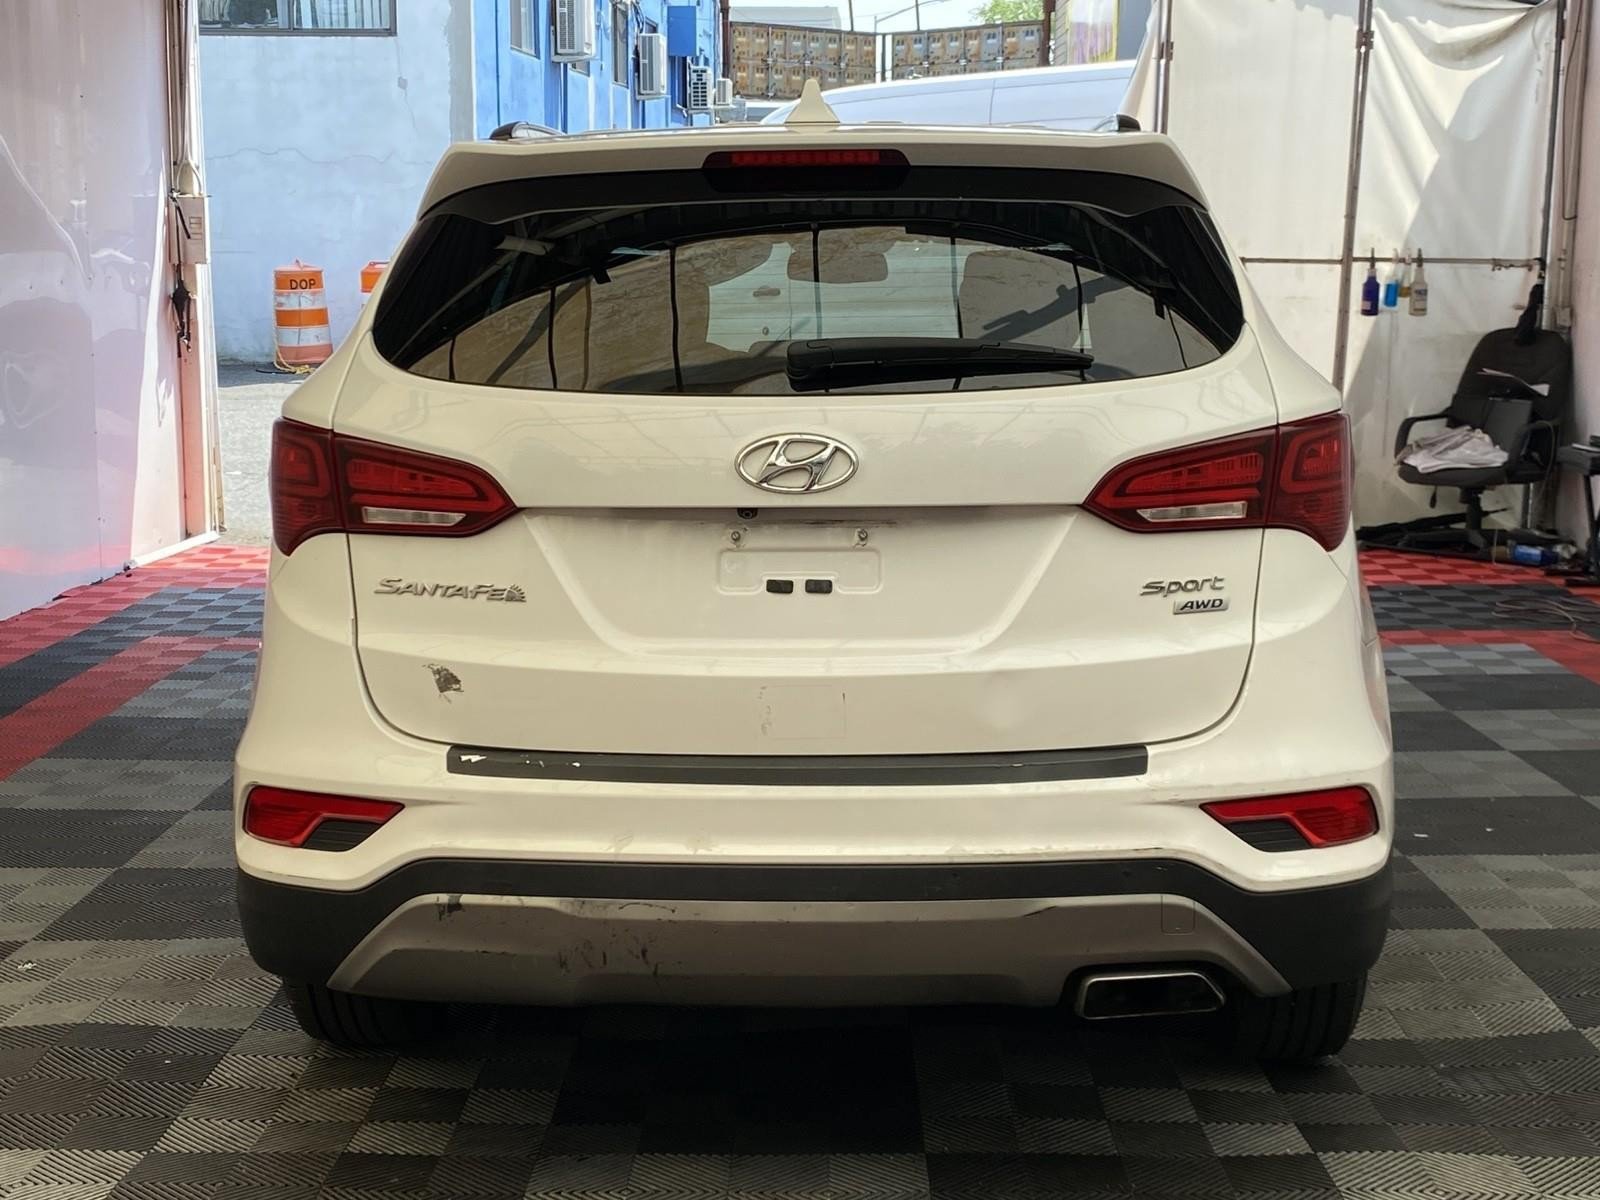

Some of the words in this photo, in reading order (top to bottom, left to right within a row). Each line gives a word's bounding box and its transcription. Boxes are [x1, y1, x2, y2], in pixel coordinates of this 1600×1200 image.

[289, 279, 316, 290] DOP
[1140, 576, 1225, 598] Sport
[1180, 598, 1224, 611] AWD
